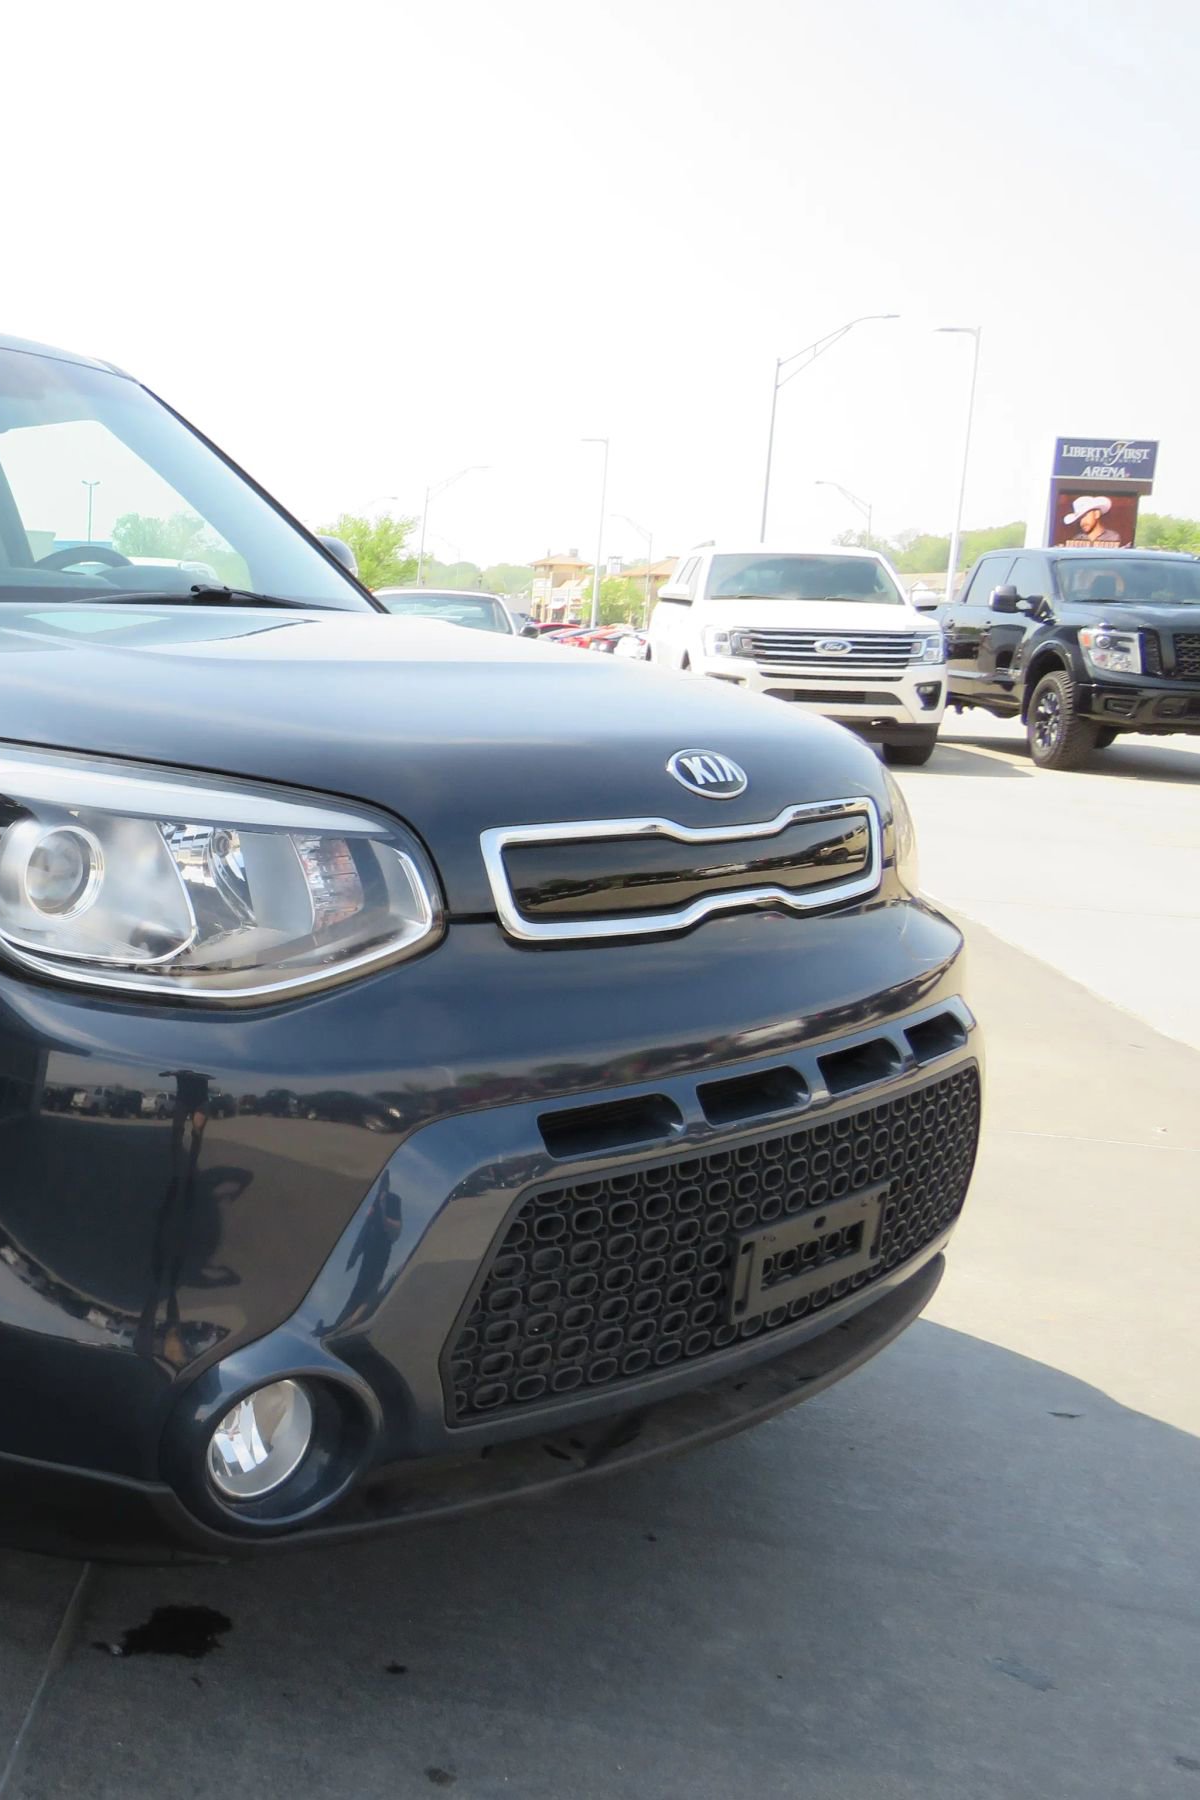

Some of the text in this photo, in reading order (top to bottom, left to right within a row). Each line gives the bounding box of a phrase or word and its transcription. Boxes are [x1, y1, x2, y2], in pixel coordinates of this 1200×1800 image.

[1062, 444, 1110, 458] LIBERTY
[1080, 465, 1126, 478] ARENA
[679, 755, 744, 785] KIA
